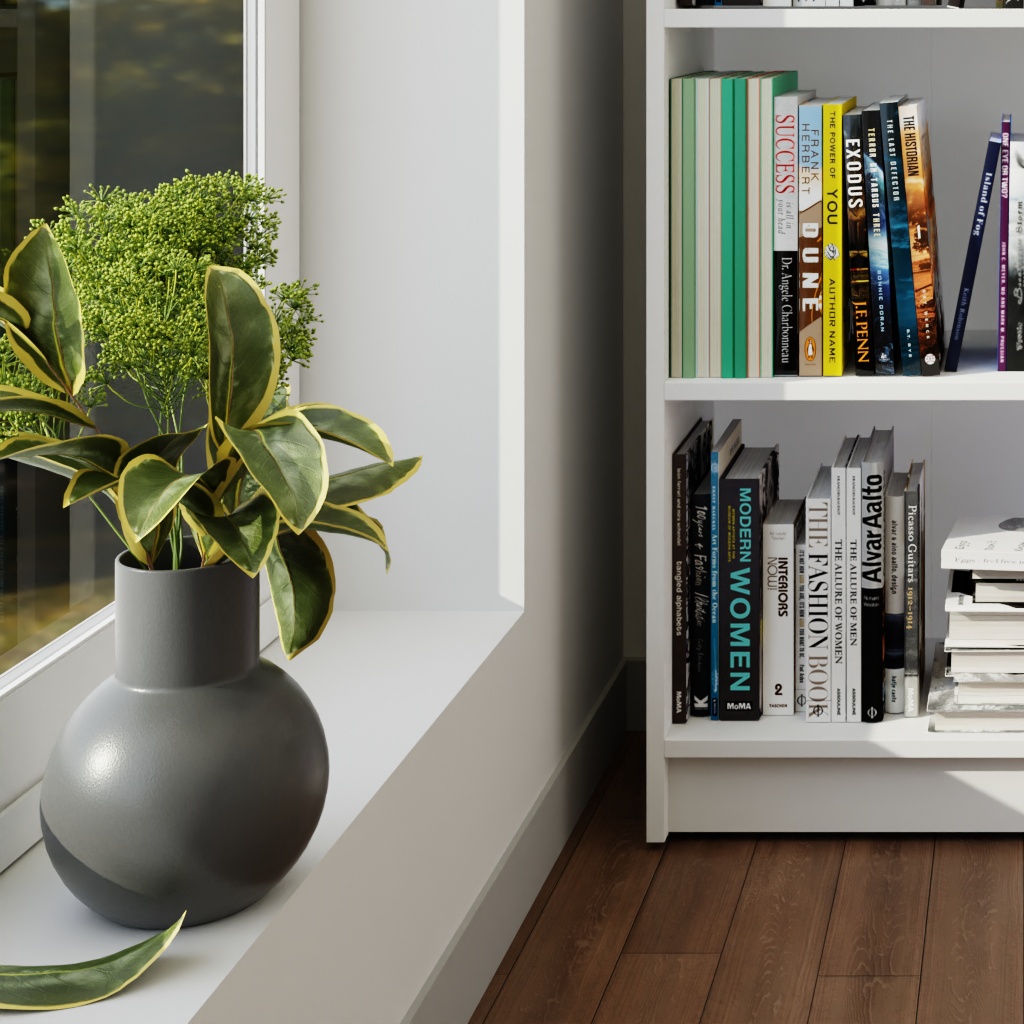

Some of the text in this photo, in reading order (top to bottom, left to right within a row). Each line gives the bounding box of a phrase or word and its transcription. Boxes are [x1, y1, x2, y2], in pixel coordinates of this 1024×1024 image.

[775, 114, 794, 193] SUCCESS
[801, 124, 809, 195] HERBERT
[811, 130, 819, 181] FRANK
[830, 167, 835, 178] OF
[846, 139, 863, 208] EXODUS
[888, 138, 896, 157] LAST
[904, 116, 919, 176] THE HISTORIAN
[827, 189, 837, 225] YOU
[890, 161, 900, 201] DEFECTOR
[972, 172, 993, 236] Island of Fog
[802, 223, 819, 311] DUNE
[780, 257, 792, 363] Dr. Angele Charbonneau
[853, 301, 869, 362] J.F. PENN
[908, 505, 917, 583] Picasso Guitars
[730, 487, 752, 691] MODERN WOMEN
[835, 608, 842, 621] OF
